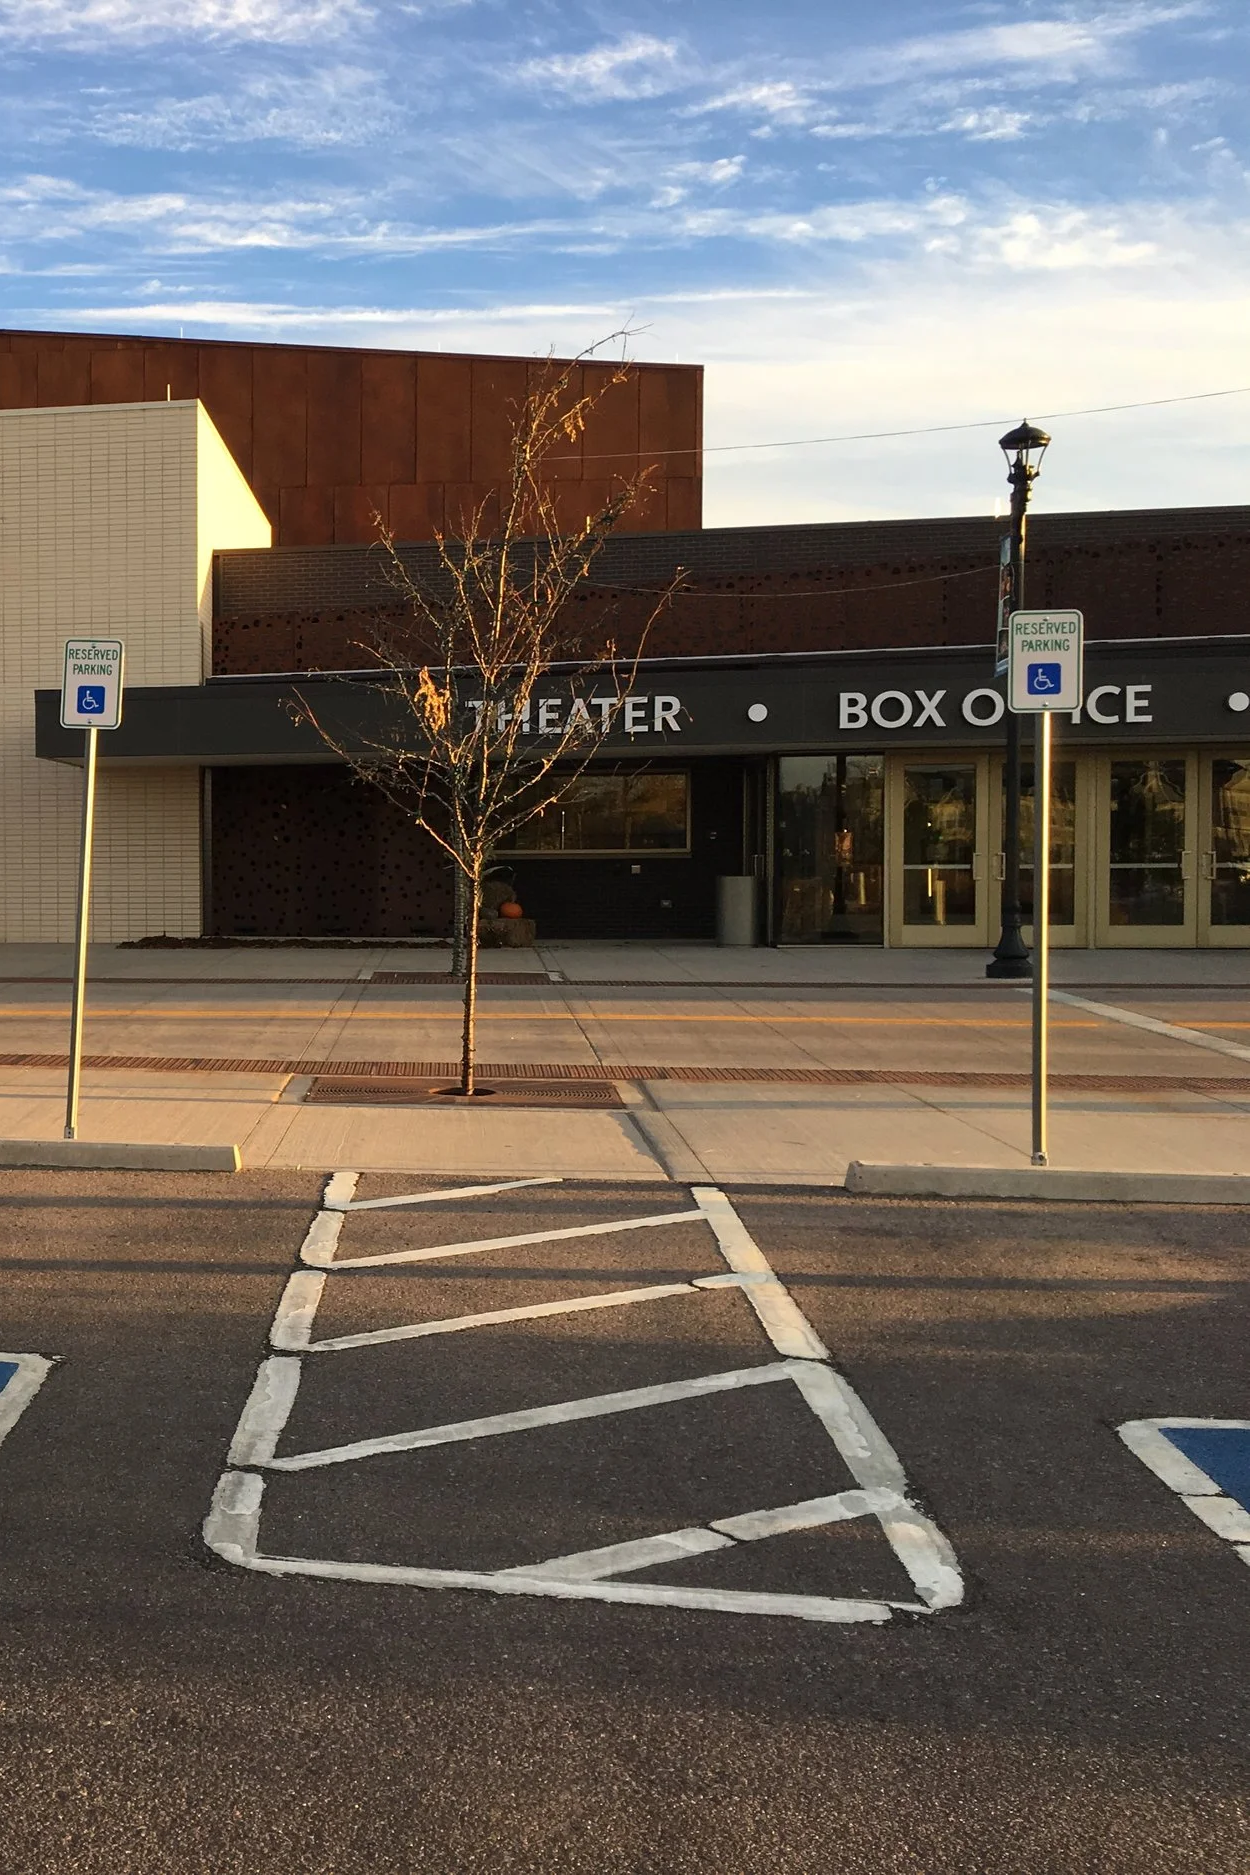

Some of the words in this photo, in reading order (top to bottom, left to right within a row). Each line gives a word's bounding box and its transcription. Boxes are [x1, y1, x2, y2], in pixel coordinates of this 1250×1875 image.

[1015, 621, 1076, 635] RESERVED
[1021, 639, 1070, 652] PARKING
[68, 648, 118, 660] RESERVED
[72, 663, 113, 676] PARKING
[839, 689, 947, 729] BOX
[962, 684, 1153, 727] OCE
[465, 695, 682, 735] THEATER
